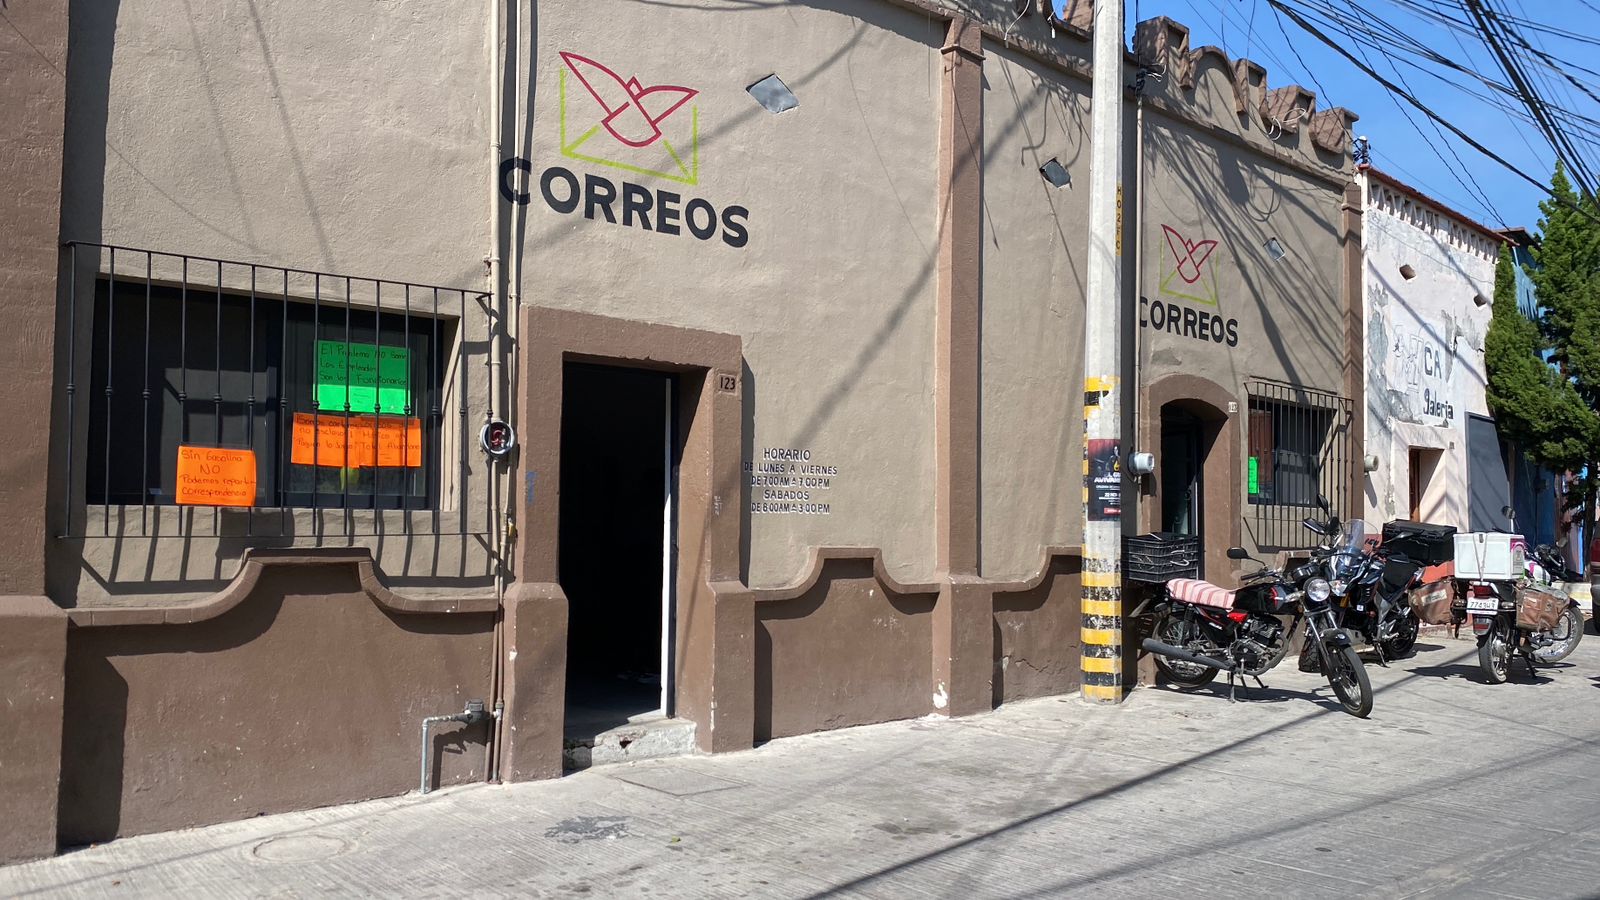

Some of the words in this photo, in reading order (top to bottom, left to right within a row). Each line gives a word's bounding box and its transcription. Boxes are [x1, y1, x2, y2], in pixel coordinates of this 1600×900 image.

[499, 157, 749, 248] CORREOS
[336, 344, 369, 358] Prlema
[720, 376, 736, 390] 123
[181, 449, 200, 461] Sin
[763, 447, 811, 461] HORARIO
[200, 464, 220, 475] NO
[744, 461, 753, 471] DE
[758, 463, 785, 474] LUNES
[789, 464, 796, 474] A
[800, 465, 838, 476] VIERNES
[751, 476, 761, 486] DE
[764, 489, 810, 501] SABADOS
[751, 502, 761, 512] DE
